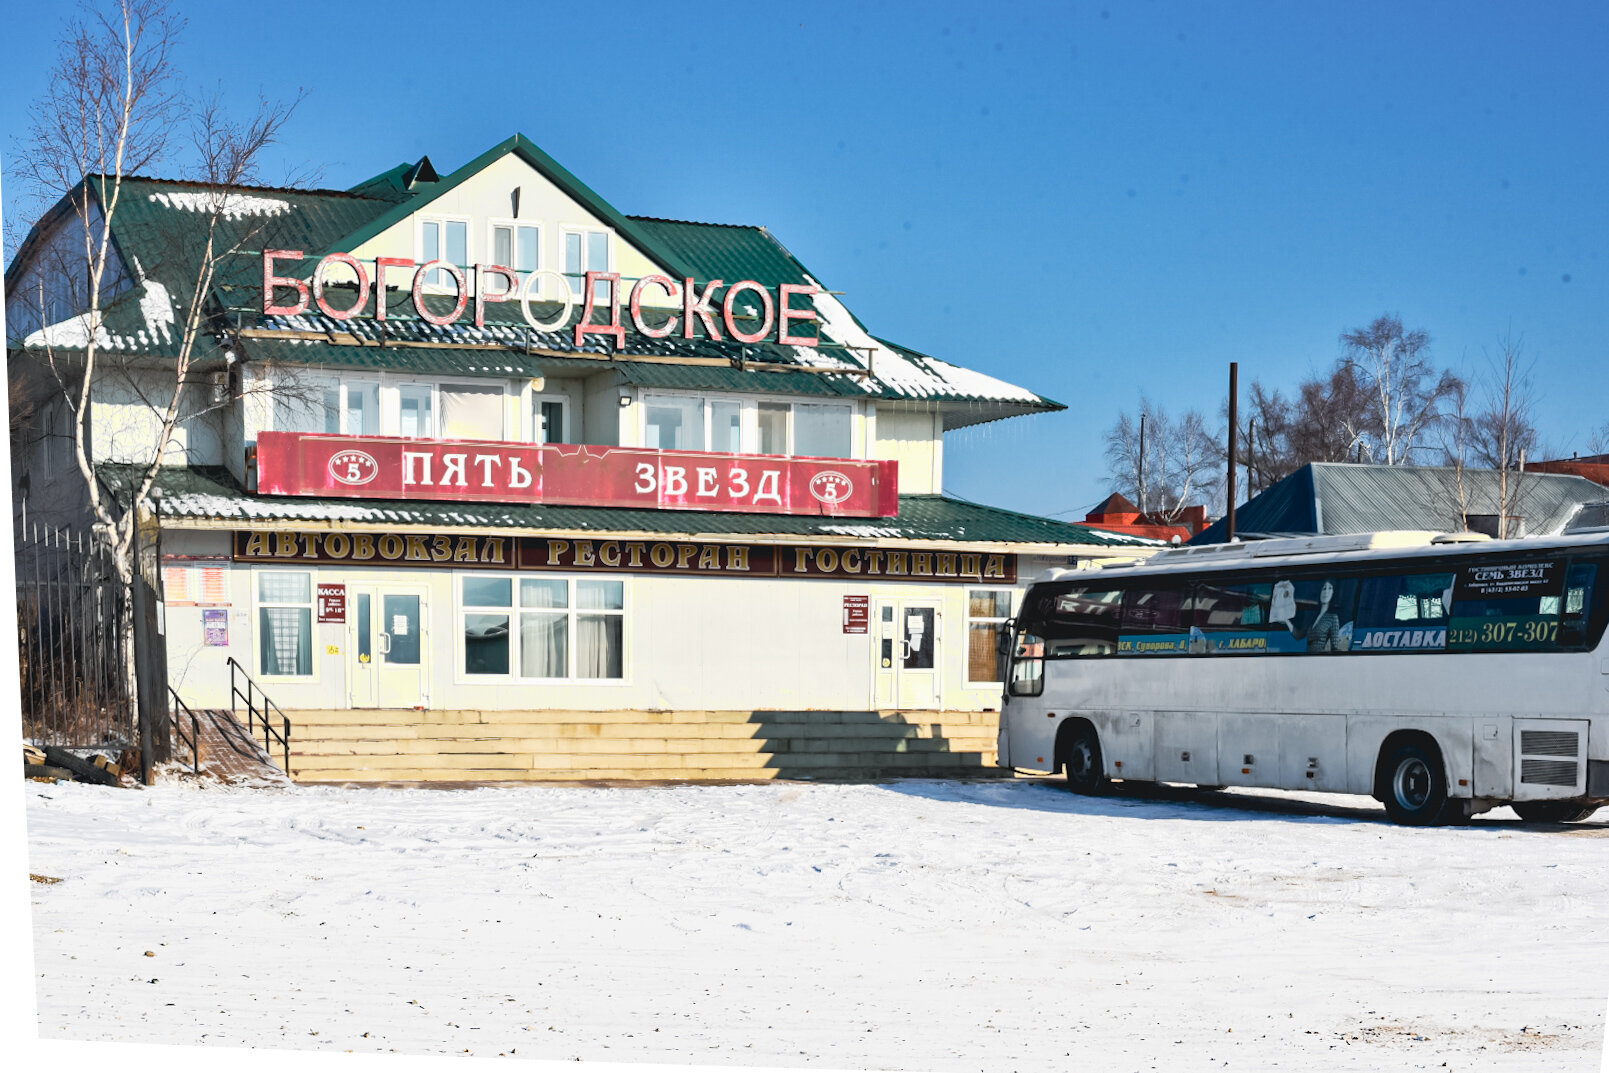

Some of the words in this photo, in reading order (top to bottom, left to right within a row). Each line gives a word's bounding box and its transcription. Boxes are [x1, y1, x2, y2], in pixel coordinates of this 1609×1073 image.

[263, 249, 820, 348] БОГОРОДСКОЕ
[346, 463, 361, 482] 5
[403, 451, 533, 488] ПЯТЬ
[634, 462, 782, 506] ЗВЕЗД
[824, 482, 838, 499] 5
[246, 531, 505, 563] АВТОВОКЗАЛ
[546, 540, 750, 571] РЕСТОРАН
[794, 547, 1006, 582] ГОСТИНИЦА
[1474, 571, 1504, 581] СЕМЬ
[1506, 568, 1544, 579] ЗВЕЗД
[318, 588, 345, 596] КАССА
[1481, 620, 1559, 643] 307-307
[1228, 638, 1266, 649] ХАБАРО
